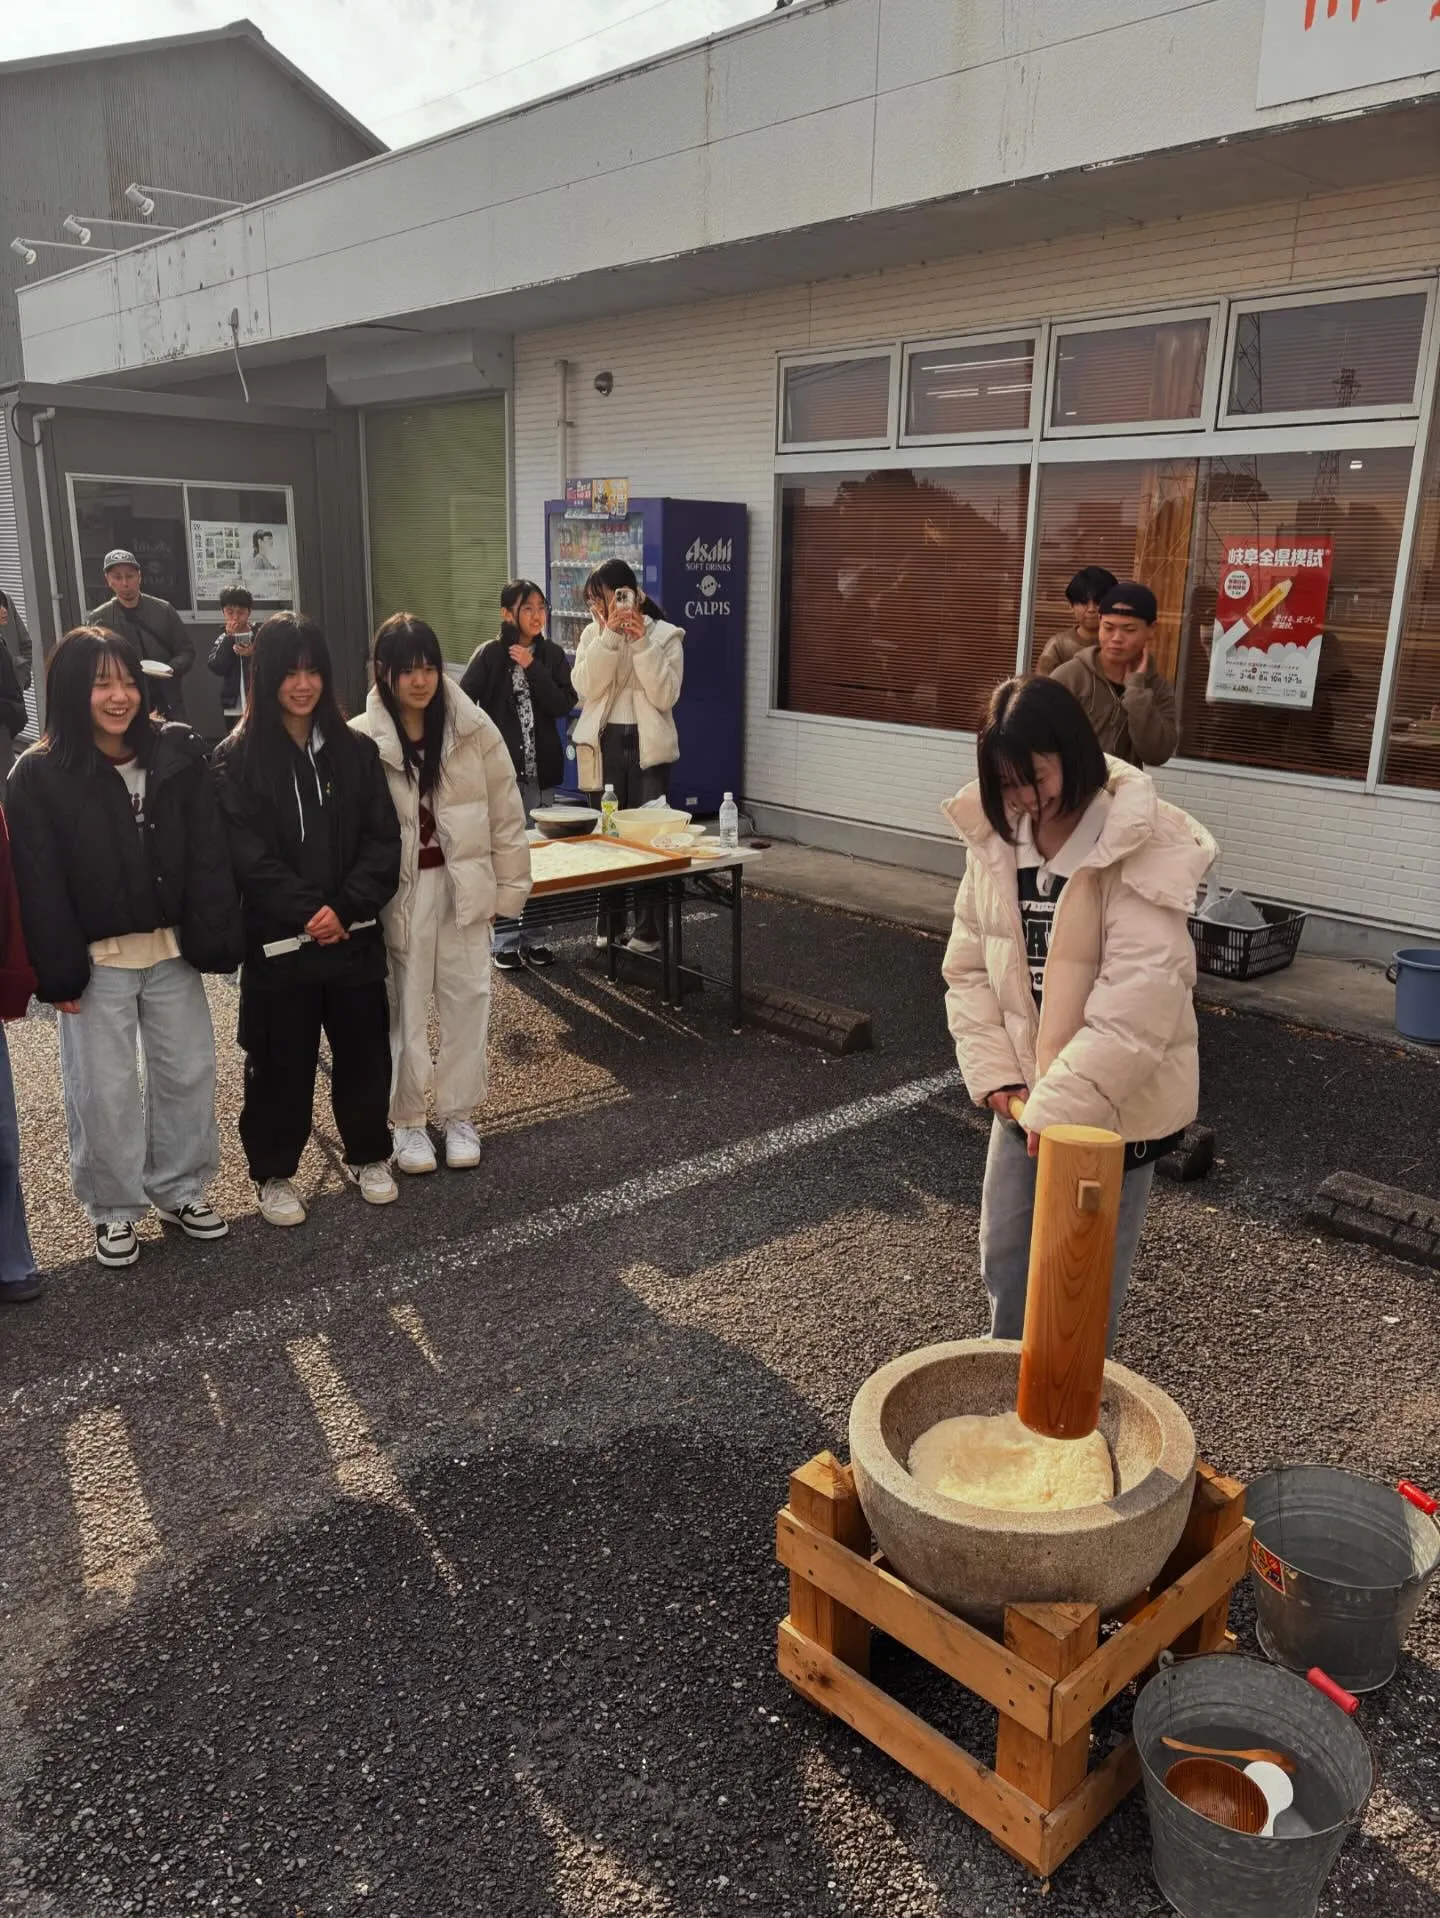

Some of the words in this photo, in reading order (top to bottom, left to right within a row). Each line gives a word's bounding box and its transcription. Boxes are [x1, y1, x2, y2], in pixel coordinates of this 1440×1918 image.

[685, 537, 732, 562] Asahi
[1227, 548, 1324, 567] 岐阜全県模試
[685, 563, 704, 571] SOFT
[705, 563, 731, 572] DRINKS
[685, 601, 730, 619] CALPIS
